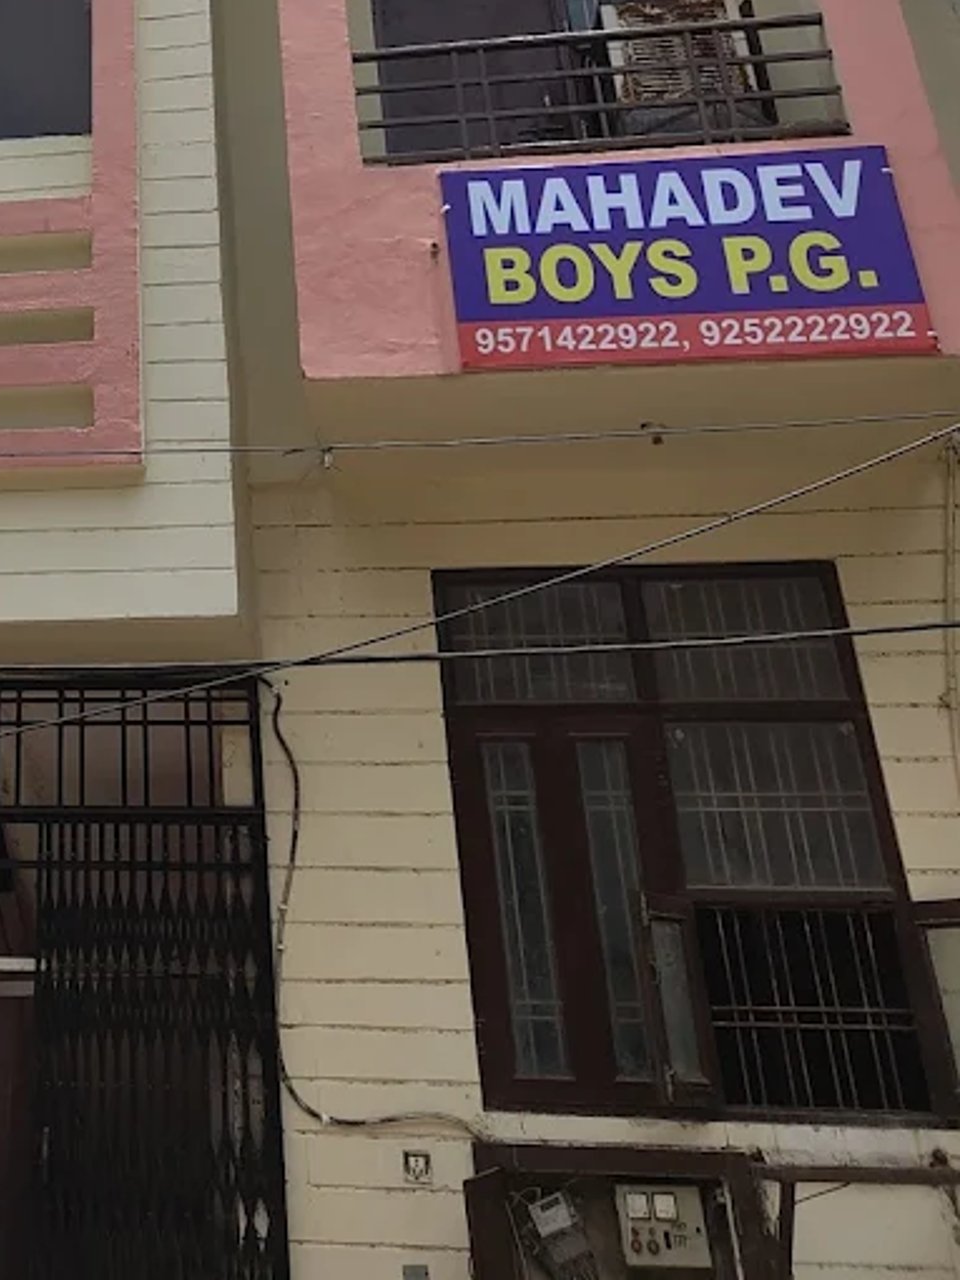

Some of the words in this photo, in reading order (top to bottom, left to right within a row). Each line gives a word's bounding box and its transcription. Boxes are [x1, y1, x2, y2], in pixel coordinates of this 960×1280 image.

[466, 160, 862, 236] MAHADEV
[483, 239, 699, 305] BOYS
[722, 231, 879, 294] P.G.
[475, 320, 690, 354] 9571422922,
[699, 311, 916, 346] 9252222922
